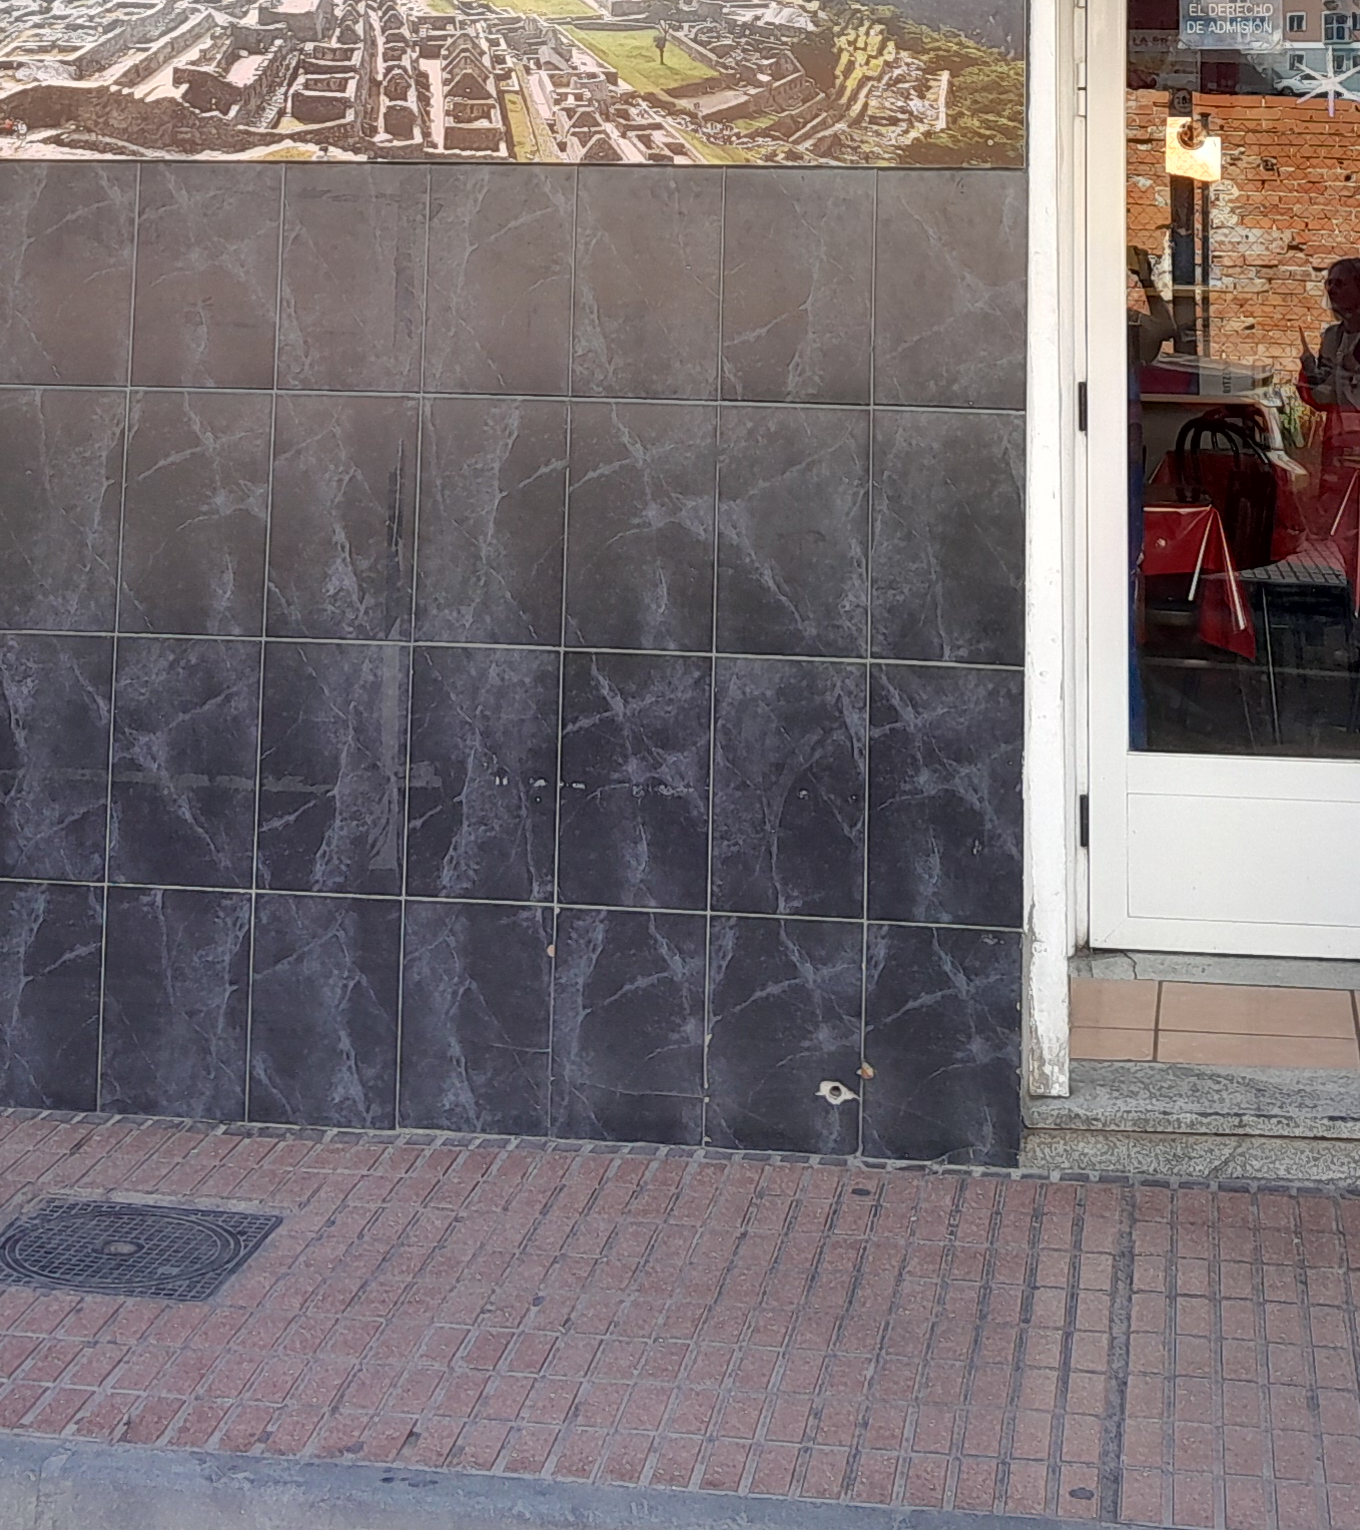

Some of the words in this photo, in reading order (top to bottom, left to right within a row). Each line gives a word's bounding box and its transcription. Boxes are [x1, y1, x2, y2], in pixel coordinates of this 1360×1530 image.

[1189, 3, 1207, 17] EL
[1208, 3, 1274, 17] DERECHO
[1186, 21, 1206, 34] DE
